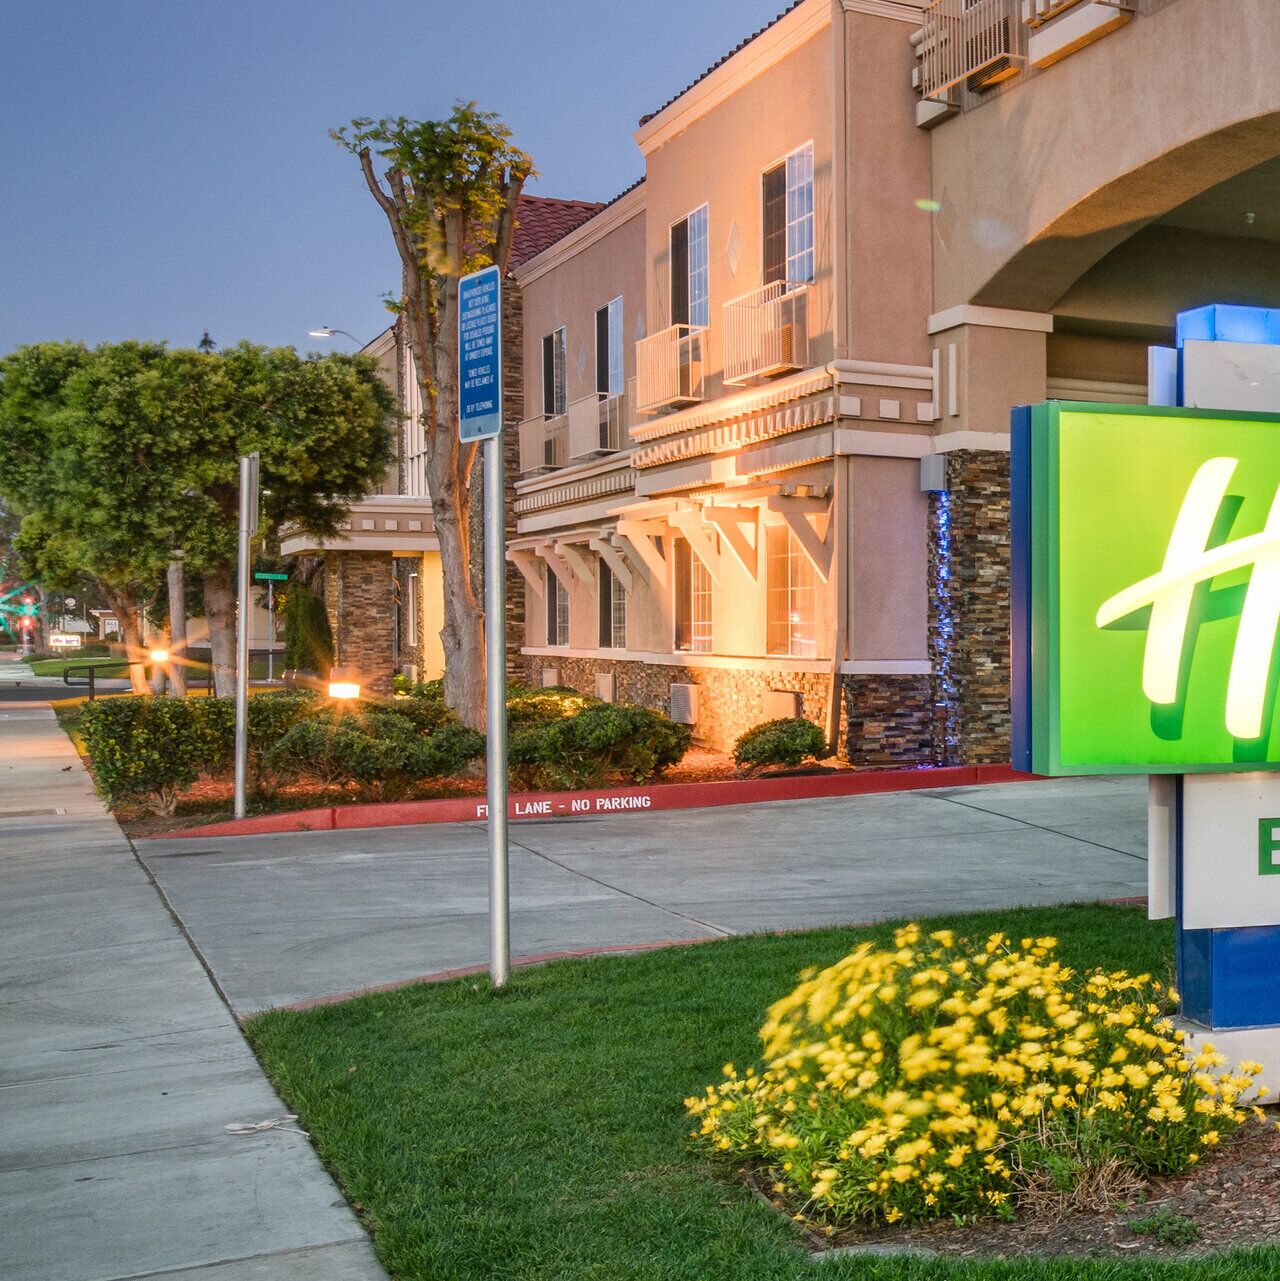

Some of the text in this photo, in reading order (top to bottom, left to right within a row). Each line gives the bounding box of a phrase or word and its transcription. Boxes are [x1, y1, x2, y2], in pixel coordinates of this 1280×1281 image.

[515, 801, 552, 815] LANE
[571, 799, 590, 811] NO
[596, 796, 651, 810] PARKING
